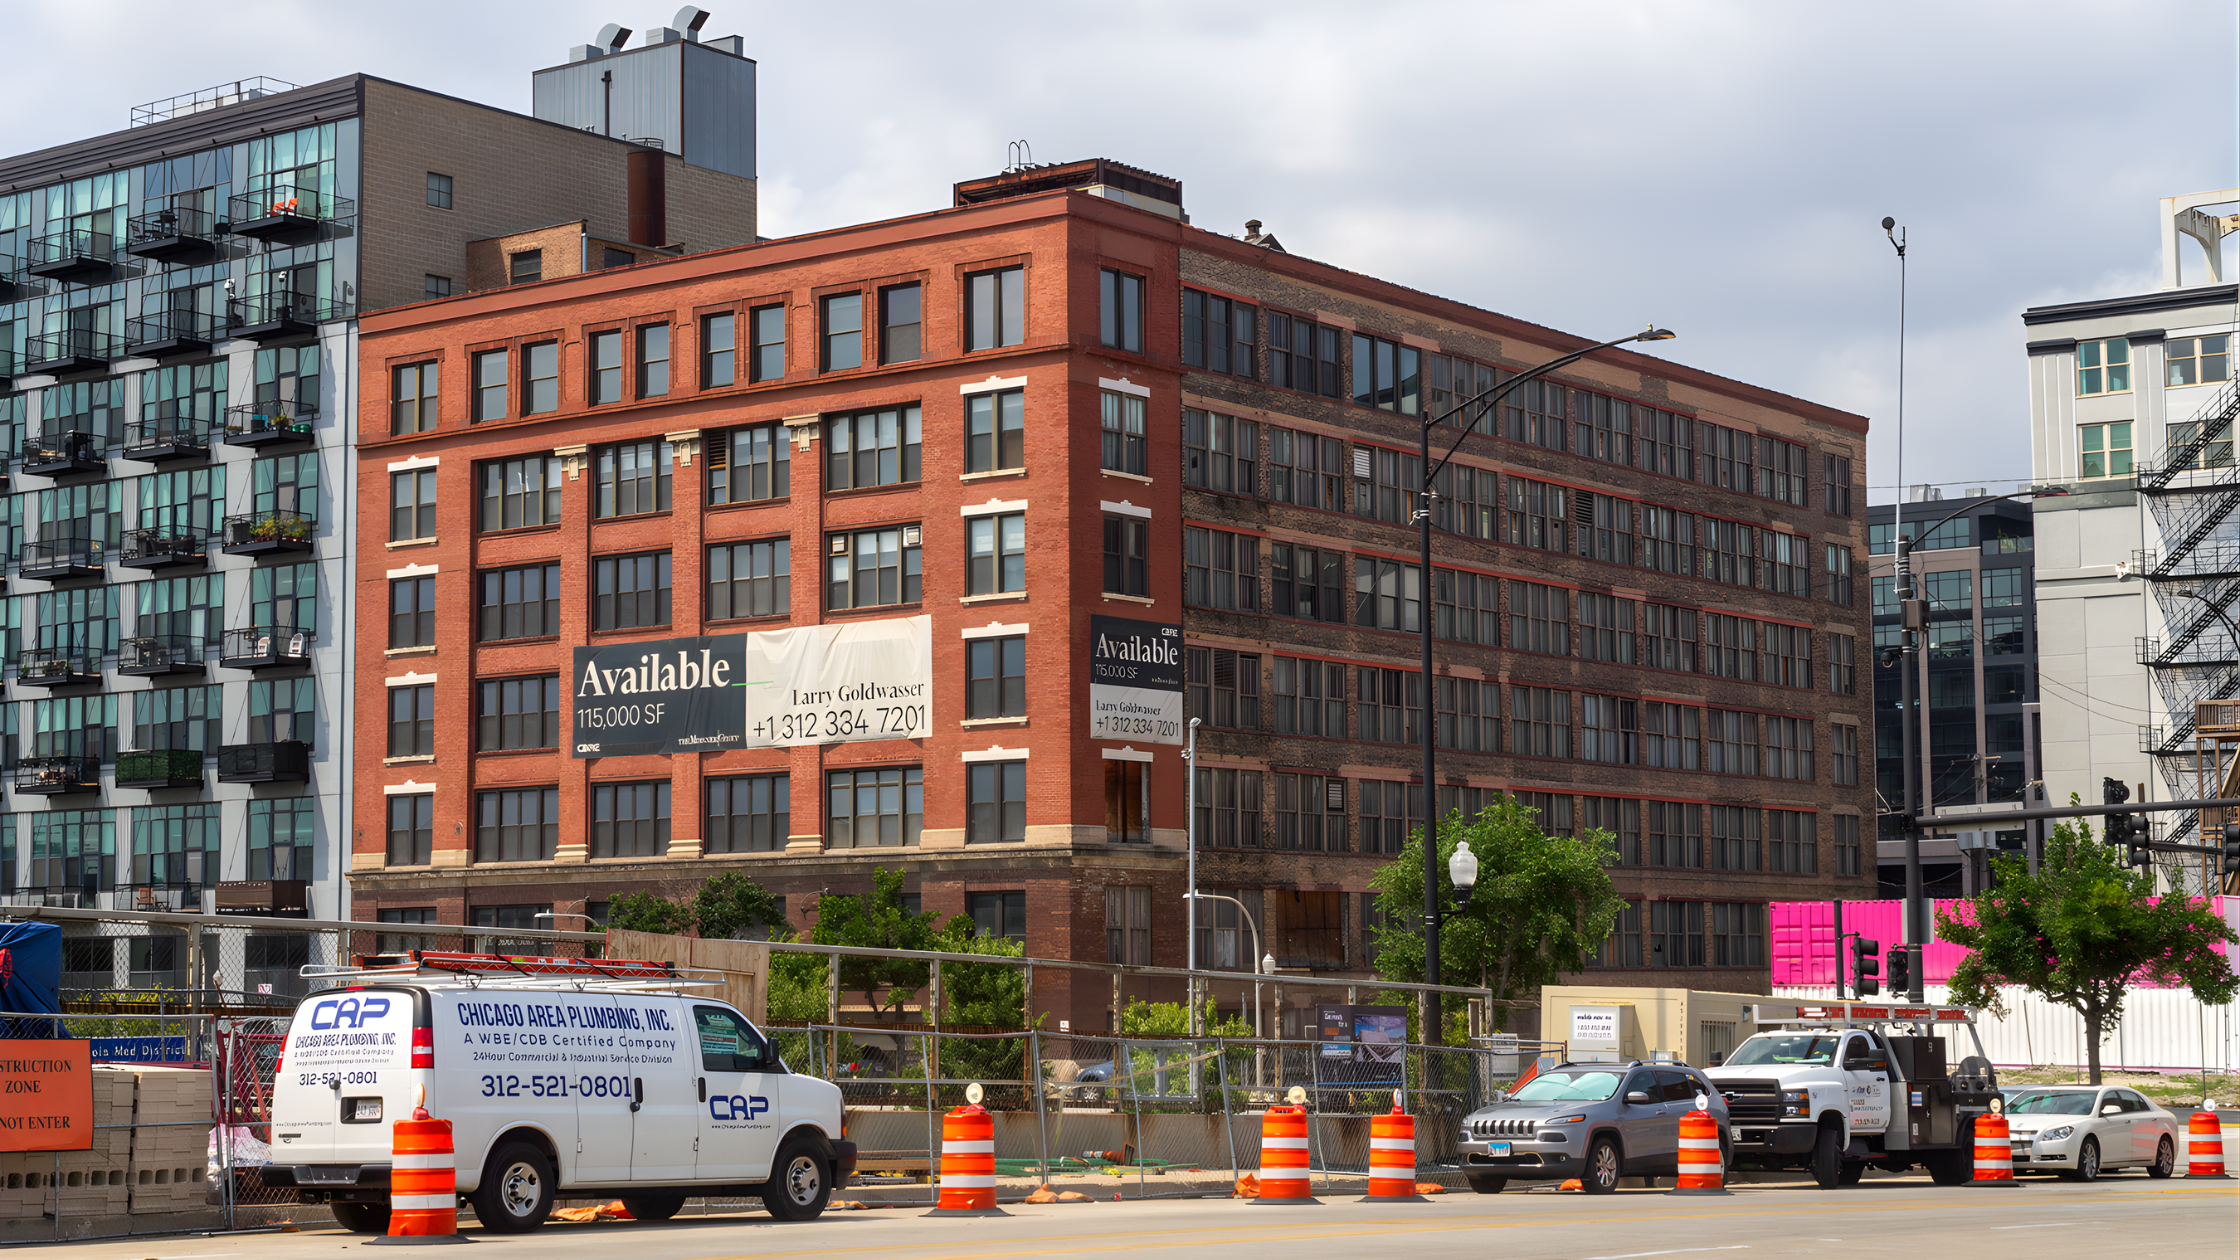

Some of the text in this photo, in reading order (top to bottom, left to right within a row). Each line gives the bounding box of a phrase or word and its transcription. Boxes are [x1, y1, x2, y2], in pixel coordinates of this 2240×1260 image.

[1096, 633, 1178, 665] Available
[577, 649, 730, 697] Available
[793, 682, 925, 708] Larry Goldwasser
[577, 703, 665, 730] 115,000 SF
[753, 704, 925, 740] +1 312 334 7201
[1111, 716, 1131, 733] 312
[1133, 718, 1153, 734] 334
[1157, 721, 1179, 737] 7201
[311, 997, 390, 1030] CAP
[458, 1002, 675, 1033] CHICAGO AREA PLUMBING, INC.
[142, 1045, 185, 1057] Disrict
[464, 1033, 676, 1051] A WBE/CDB Certified Company
[5, 1080, 42, 1094] ZONE
[481, 1075, 632, 1098] 312-521-0801
[709, 1095, 769, 1120] CAP
[0, 1115, 71, 1130] NOT ENTER
